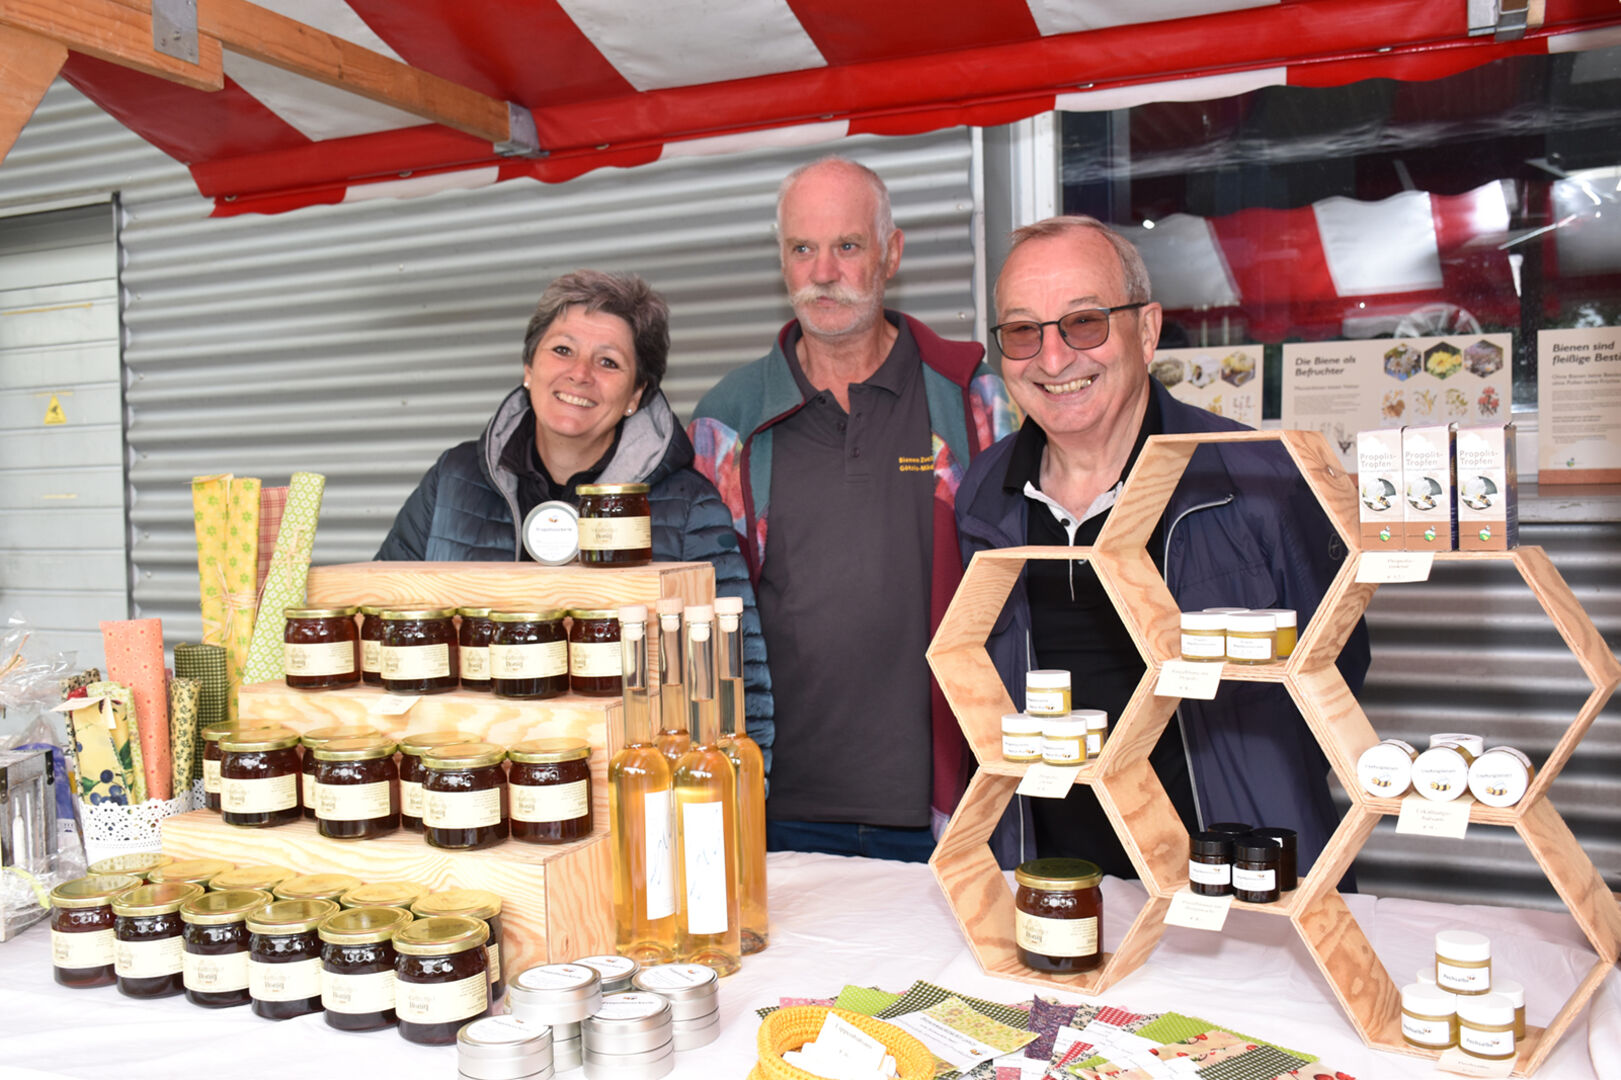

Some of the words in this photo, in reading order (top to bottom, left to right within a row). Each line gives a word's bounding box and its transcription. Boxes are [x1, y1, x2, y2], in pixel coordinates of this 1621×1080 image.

[1552, 343, 1590, 353] Bienen
[1593, 341, 1615, 351] sind
[1295, 357, 1311, 366] Die
[1314, 356, 1340, 365] Biene
[1343, 355, 1356, 364] als
[1552, 353, 1591, 366] fleißige
[1295, 367, 1344, 378] Befruchter
[1361, 461, 1391, 469] Tropfen
[1406, 459, 1438, 468] Tropfen
[1460, 458, 1493, 466] Tropfen
